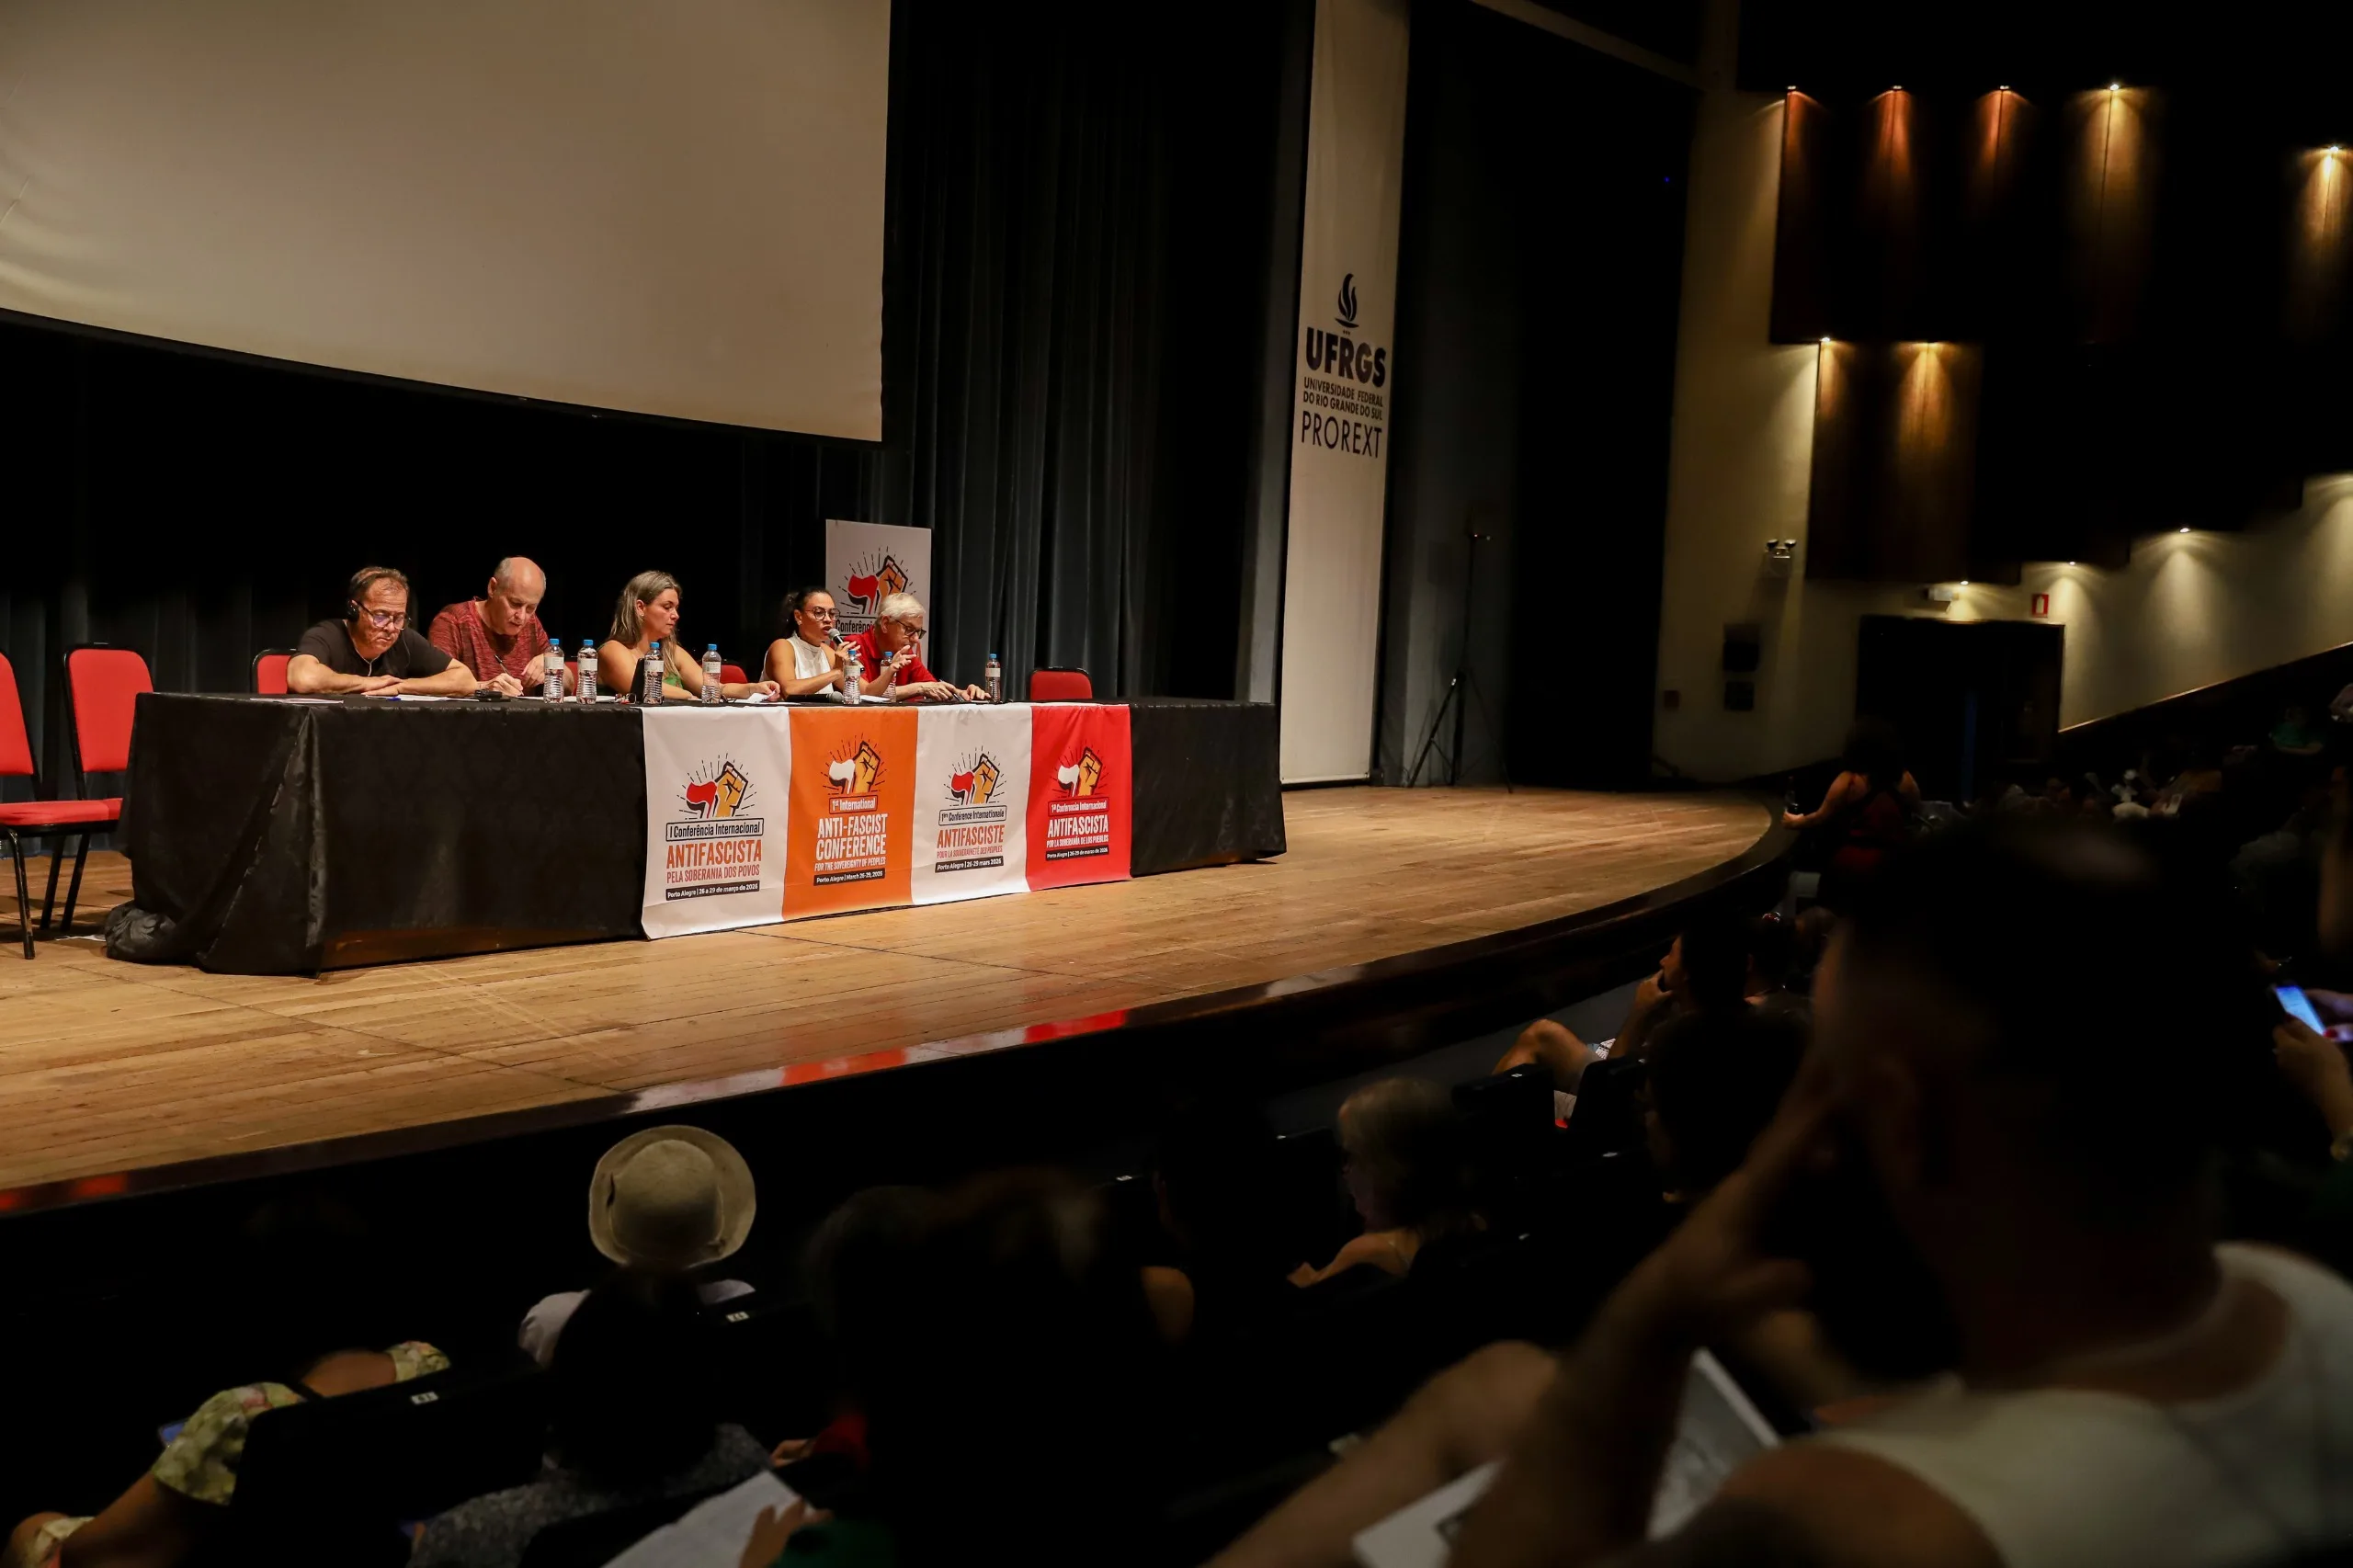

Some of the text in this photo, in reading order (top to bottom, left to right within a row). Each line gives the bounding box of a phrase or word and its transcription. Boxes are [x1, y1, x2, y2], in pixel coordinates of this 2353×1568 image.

[1306, 326, 1386, 388] UFRGS
[1304, 377, 1383, 407] UNIVERSIDADE FEDERAL
[1303, 391, 1382, 420] DO RIO GRANDE DO SUL
[1302, 410, 1381, 459] PROREXT
[835, 619, 874, 632] Conferênc
[840, 798, 876, 811] International
[972, 809, 1005, 820] Internationale
[670, 822, 760, 838] I Conferência Internacional
[817, 813, 888, 838] ANTI-FASCIST
[937, 824, 1005, 848] ANTIFASCISTE
[1048, 814, 1108, 838] ANTIFASCISTA
[666, 839, 761, 869] ANTIFASCISTA
[816, 835, 887, 861] CONFERENCE
[667, 864, 760, 883] PELA SOBERANIA DOS POVOS
[814, 862, 824, 871] FOR
[824, 862, 834, 870] THE
[868, 857, 886, 867] PEOPLES
[723, 885, 739, 893] março
